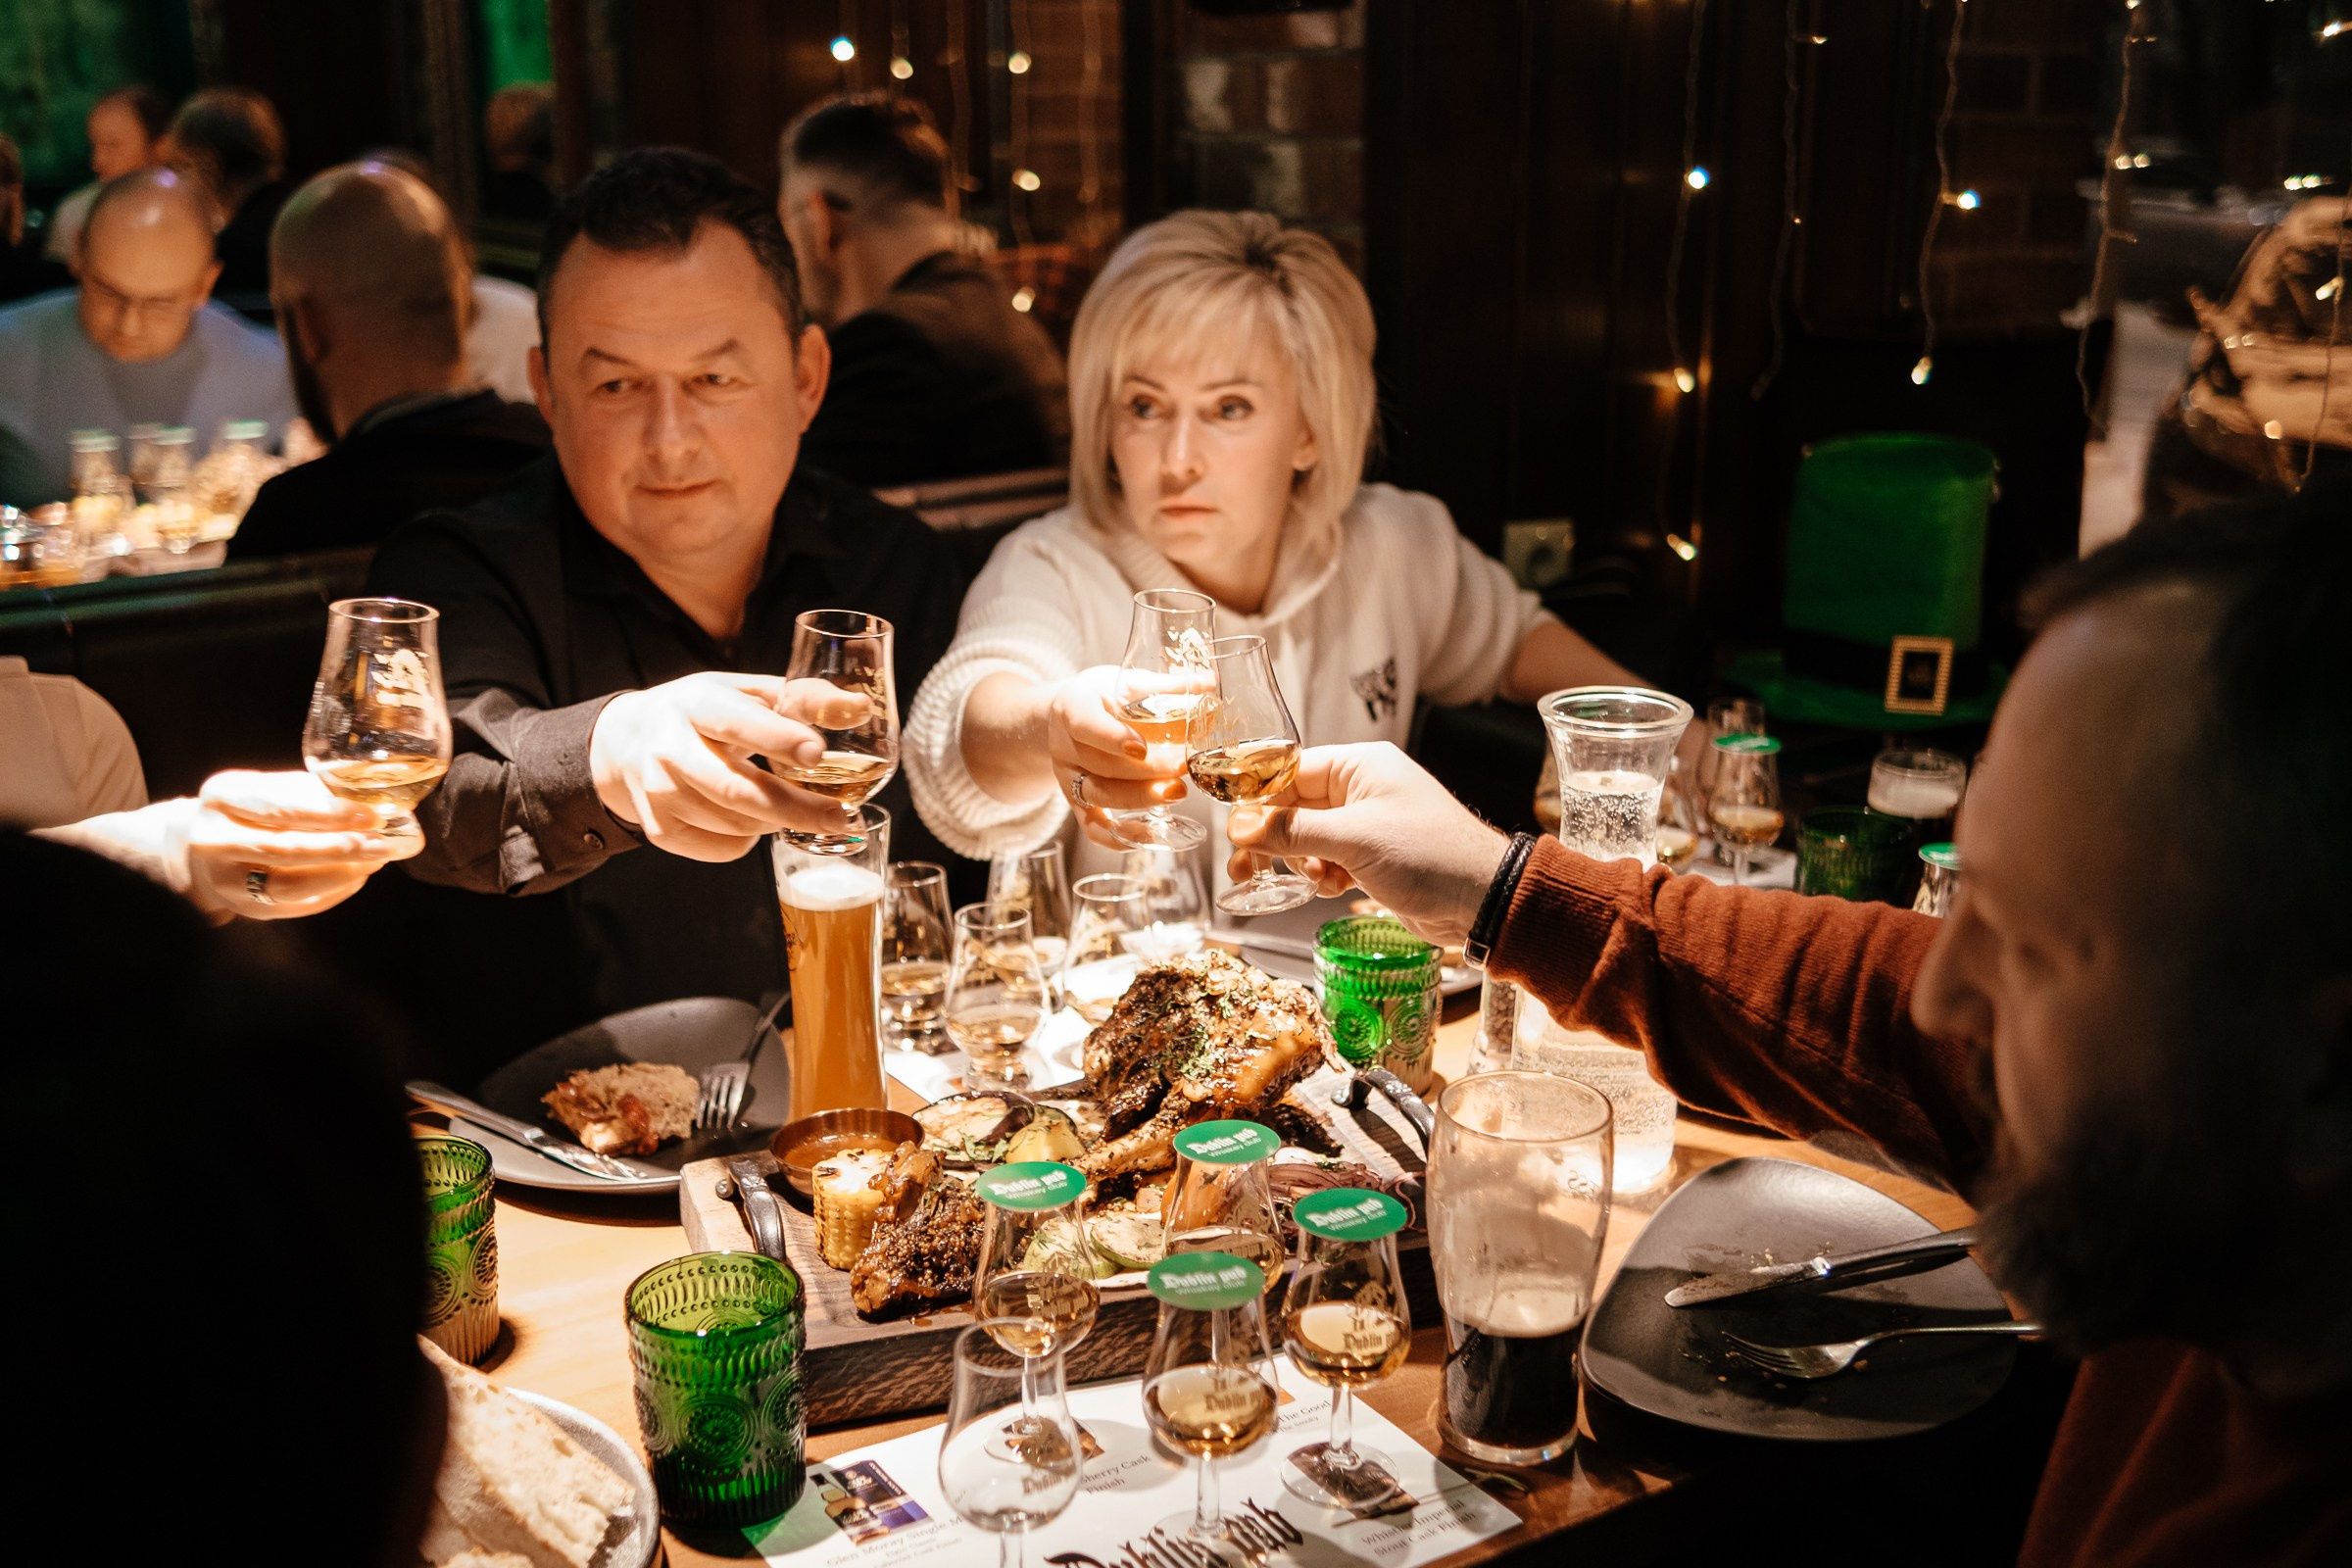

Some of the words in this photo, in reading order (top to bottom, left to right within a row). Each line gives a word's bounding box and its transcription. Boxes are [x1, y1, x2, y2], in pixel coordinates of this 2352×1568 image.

[1186, 1137, 1237, 1154] Dublin
[1233, 1128, 1258, 1142] pub
[988, 1179, 1041, 1196] Dublin
[1041, 1170, 1067, 1186] pub
[1304, 1207, 1360, 1227] Dublin
[1355, 1198, 1384, 1215] pub
[1300, 1400, 1331, 1414] Good
[1121, 1454, 1152, 1470] Cask
[1086, 1478, 1126, 1495] Finish
